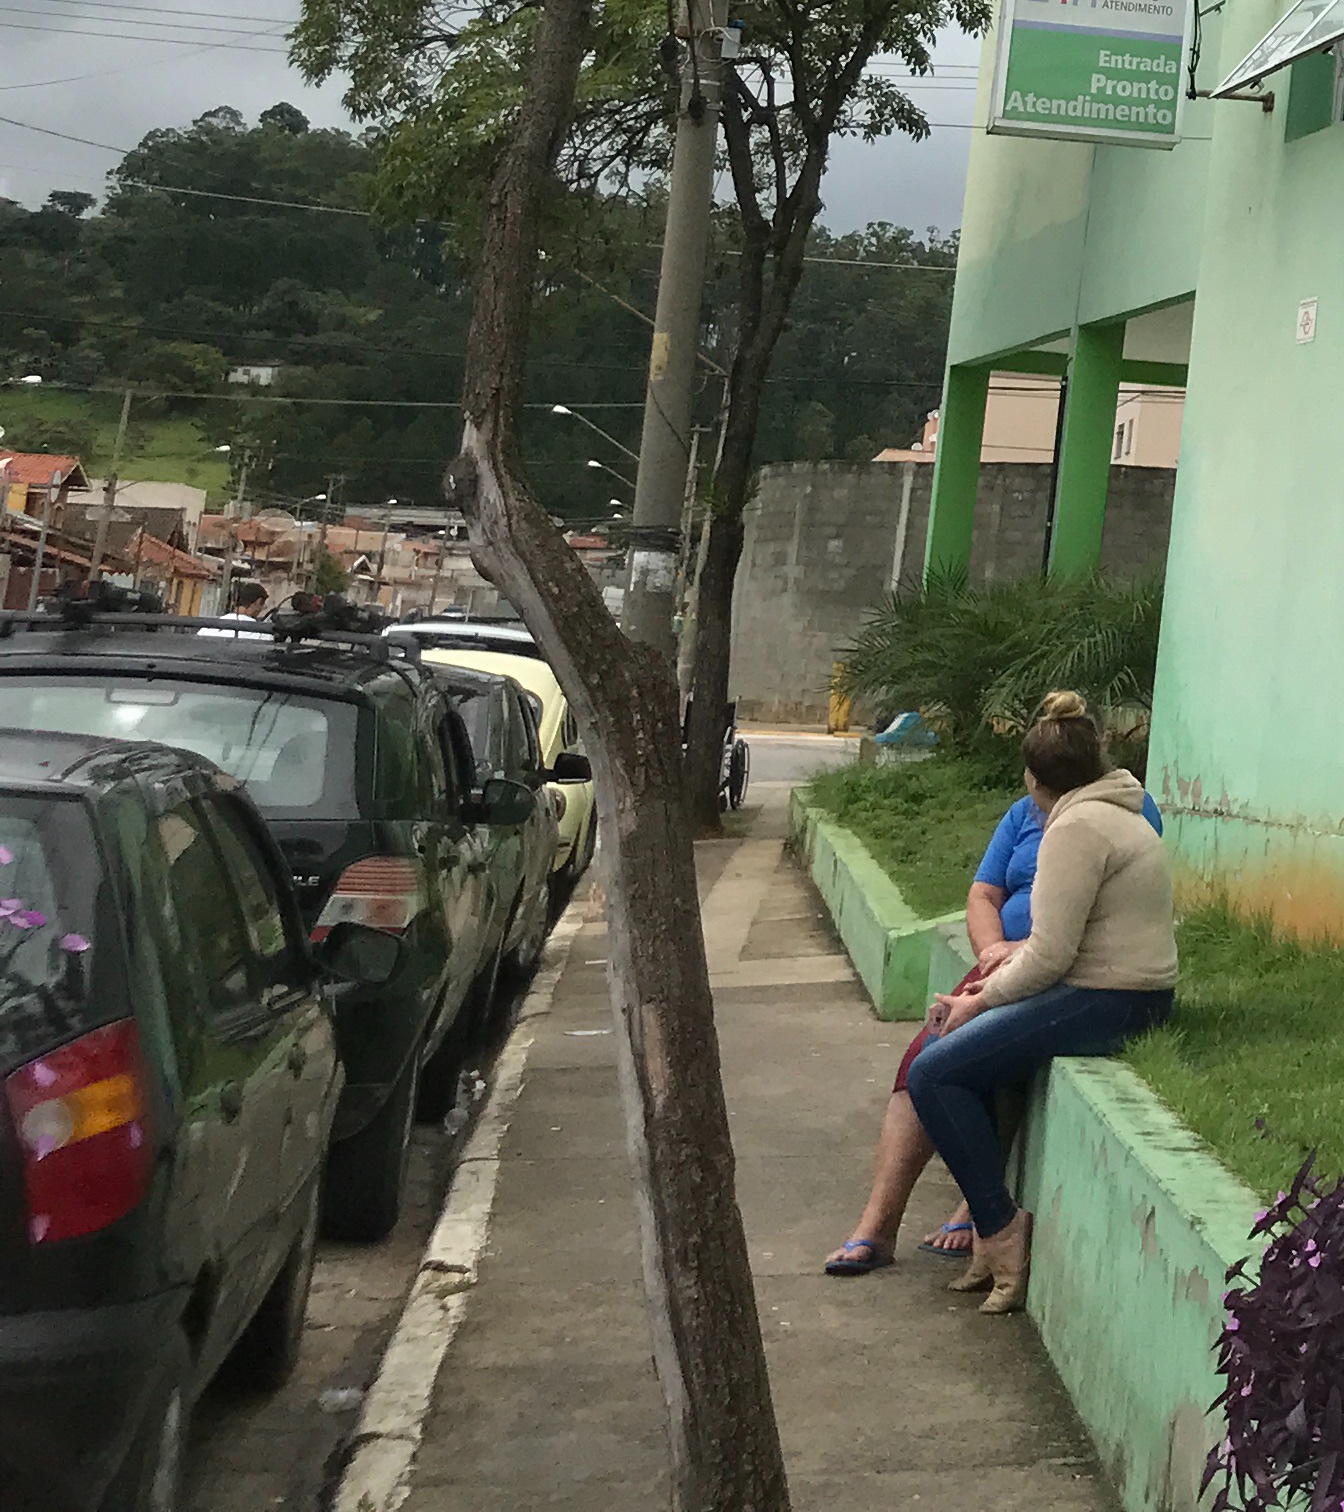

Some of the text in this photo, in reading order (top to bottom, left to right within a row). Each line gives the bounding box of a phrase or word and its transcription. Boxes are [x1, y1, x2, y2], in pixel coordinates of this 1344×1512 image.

[1101, 0, 1174, 17] ATENDIMENTO
[1098, 49, 1177, 74] Entrada
[1090, 73, 1175, 101] Pronto
[1004, 90, 1173, 126] Atendimento
